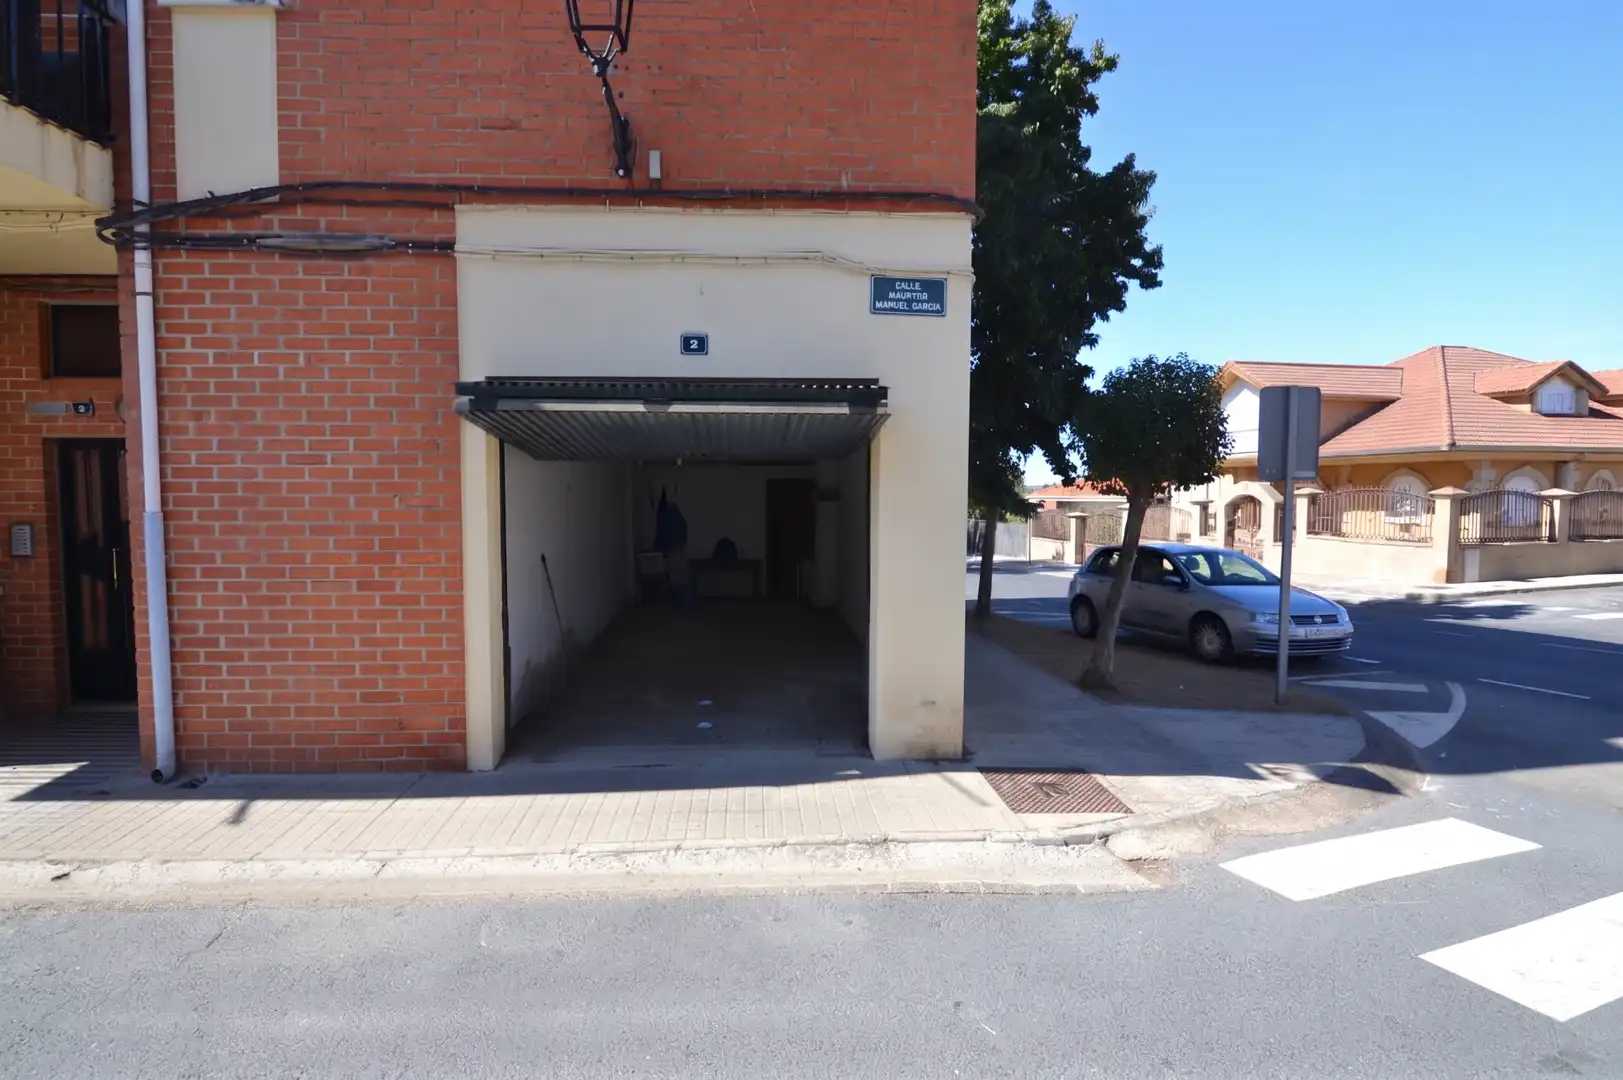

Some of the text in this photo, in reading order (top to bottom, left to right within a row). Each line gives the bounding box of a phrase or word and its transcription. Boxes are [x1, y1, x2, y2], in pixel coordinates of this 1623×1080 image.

[895, 281, 921, 290] CALLE
[875, 300, 941, 311] MANUEL GARCIA
[690, 339, 699, 349] 2
[78, 405, 85, 413] 2
